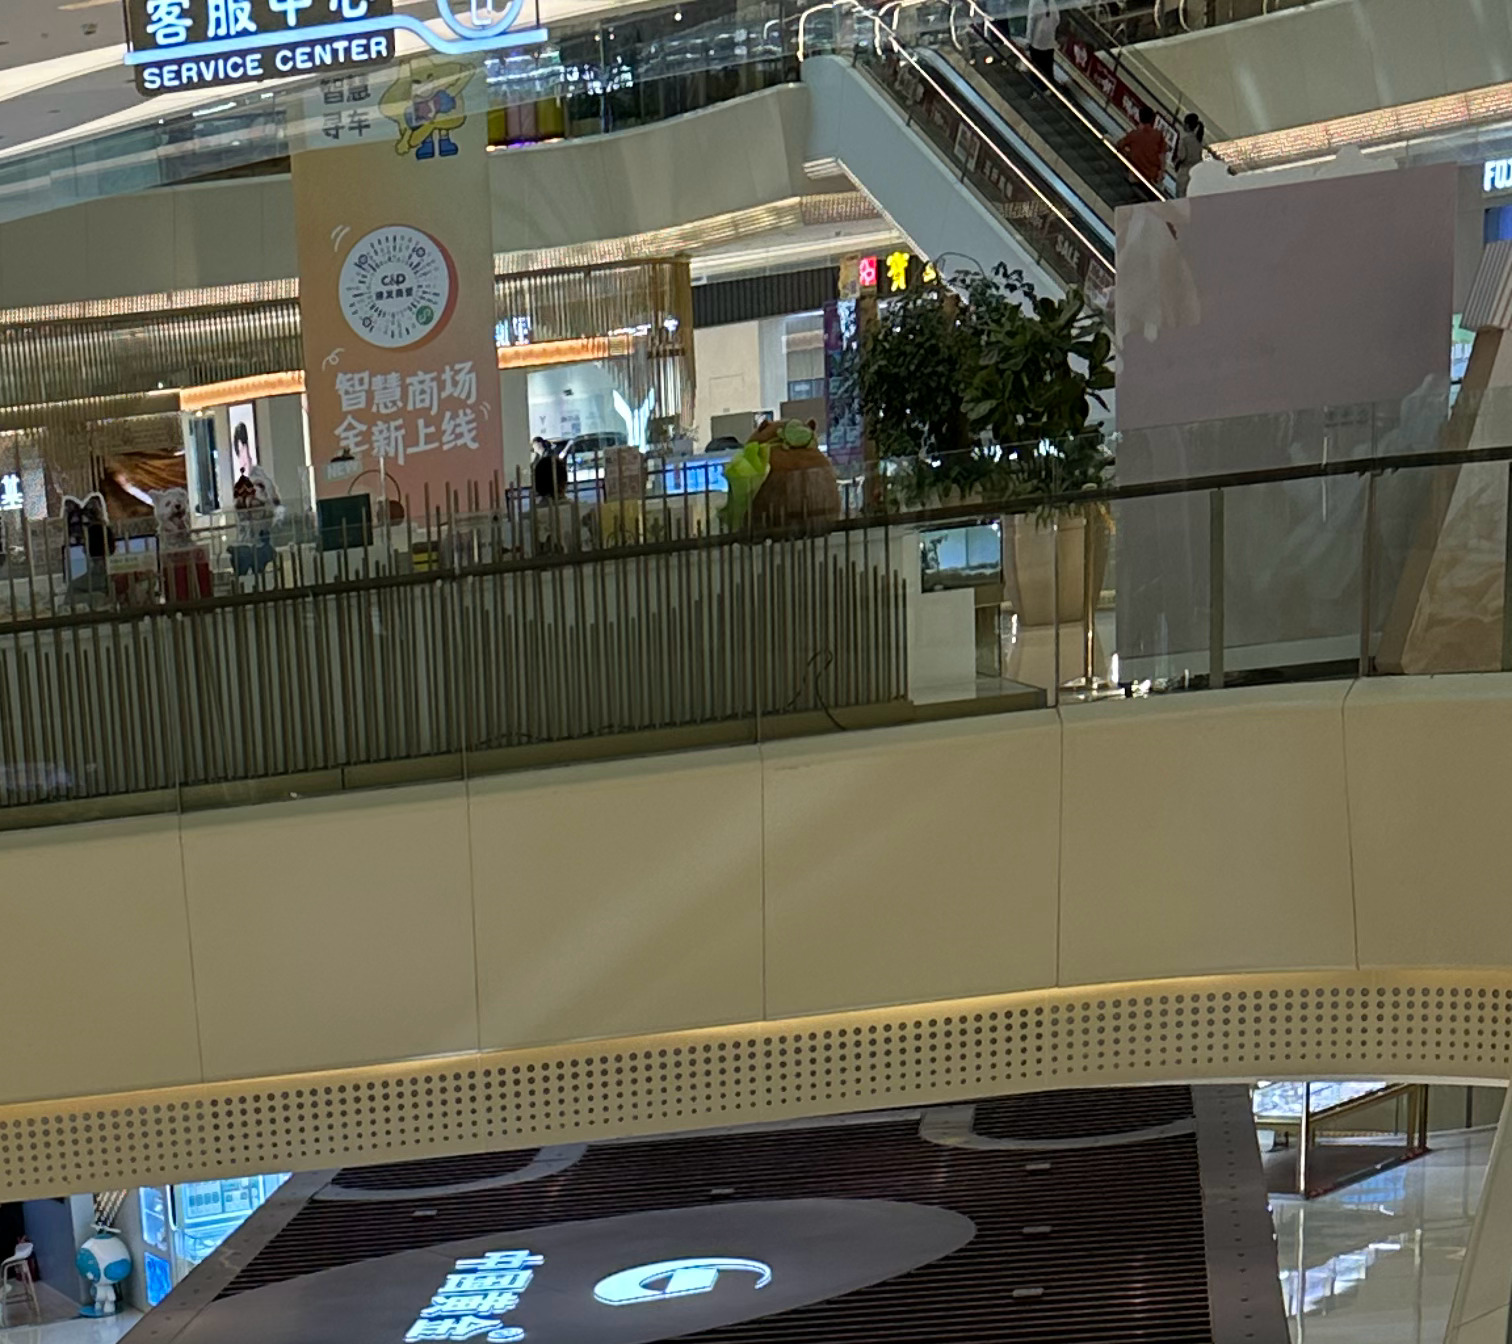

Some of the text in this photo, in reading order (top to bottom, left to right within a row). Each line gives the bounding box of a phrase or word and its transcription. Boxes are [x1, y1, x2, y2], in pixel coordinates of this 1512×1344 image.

[143, 37, 388, 89] SERVICE CENTER
[321, 76, 372, 105] 智慧
[321, 112, 372, 141] 寻车
[335, 361, 477, 416] 智慧商场
[334, 408, 480, 467] 全新上线
